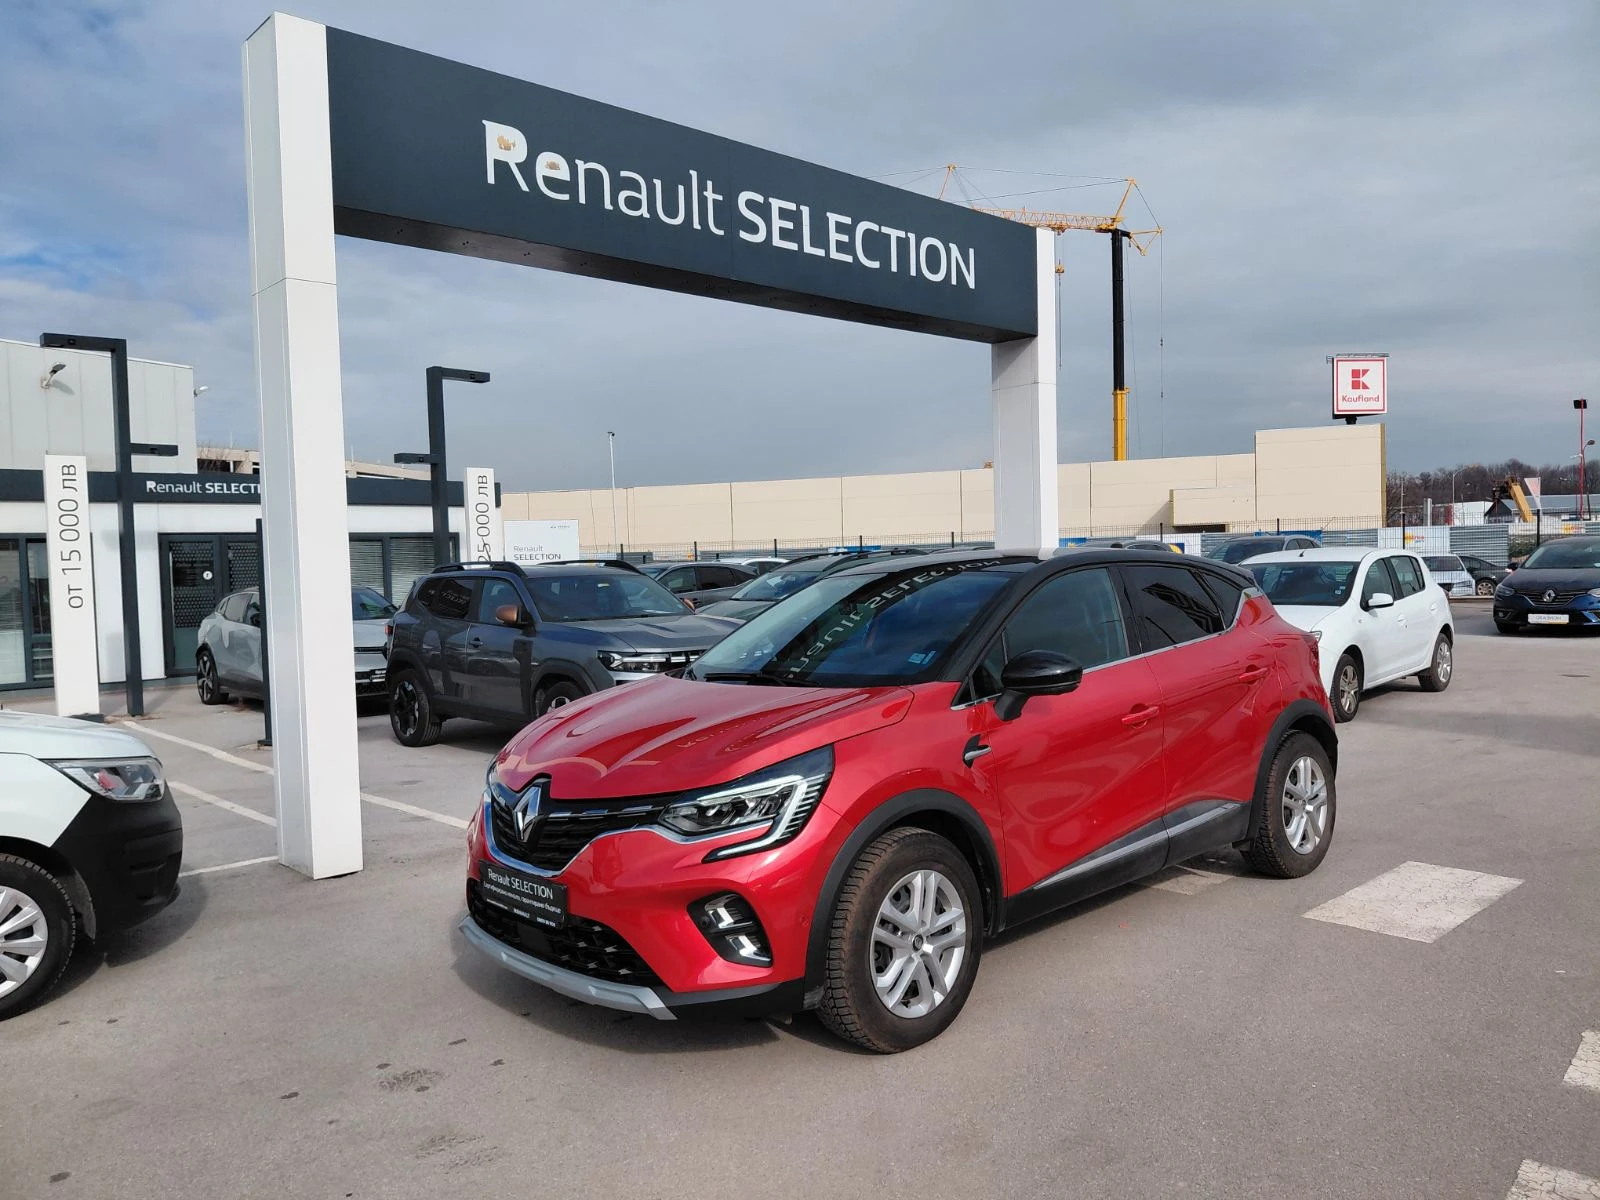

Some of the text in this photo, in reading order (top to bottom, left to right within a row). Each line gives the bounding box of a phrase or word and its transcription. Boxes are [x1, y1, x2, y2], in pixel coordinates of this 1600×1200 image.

[482, 119, 976, 290] Renault SELECTION
[1341, 394, 1379, 403] Kaufland
[145, 480, 202, 494] Renault
[475, 502, 491, 537] 000
[57, 464, 84, 609] от 15 000 лв
[513, 553, 561, 561] SELECTION
[487, 868, 511, 888] Renault
[511, 876, 554, 900] SELECTION
